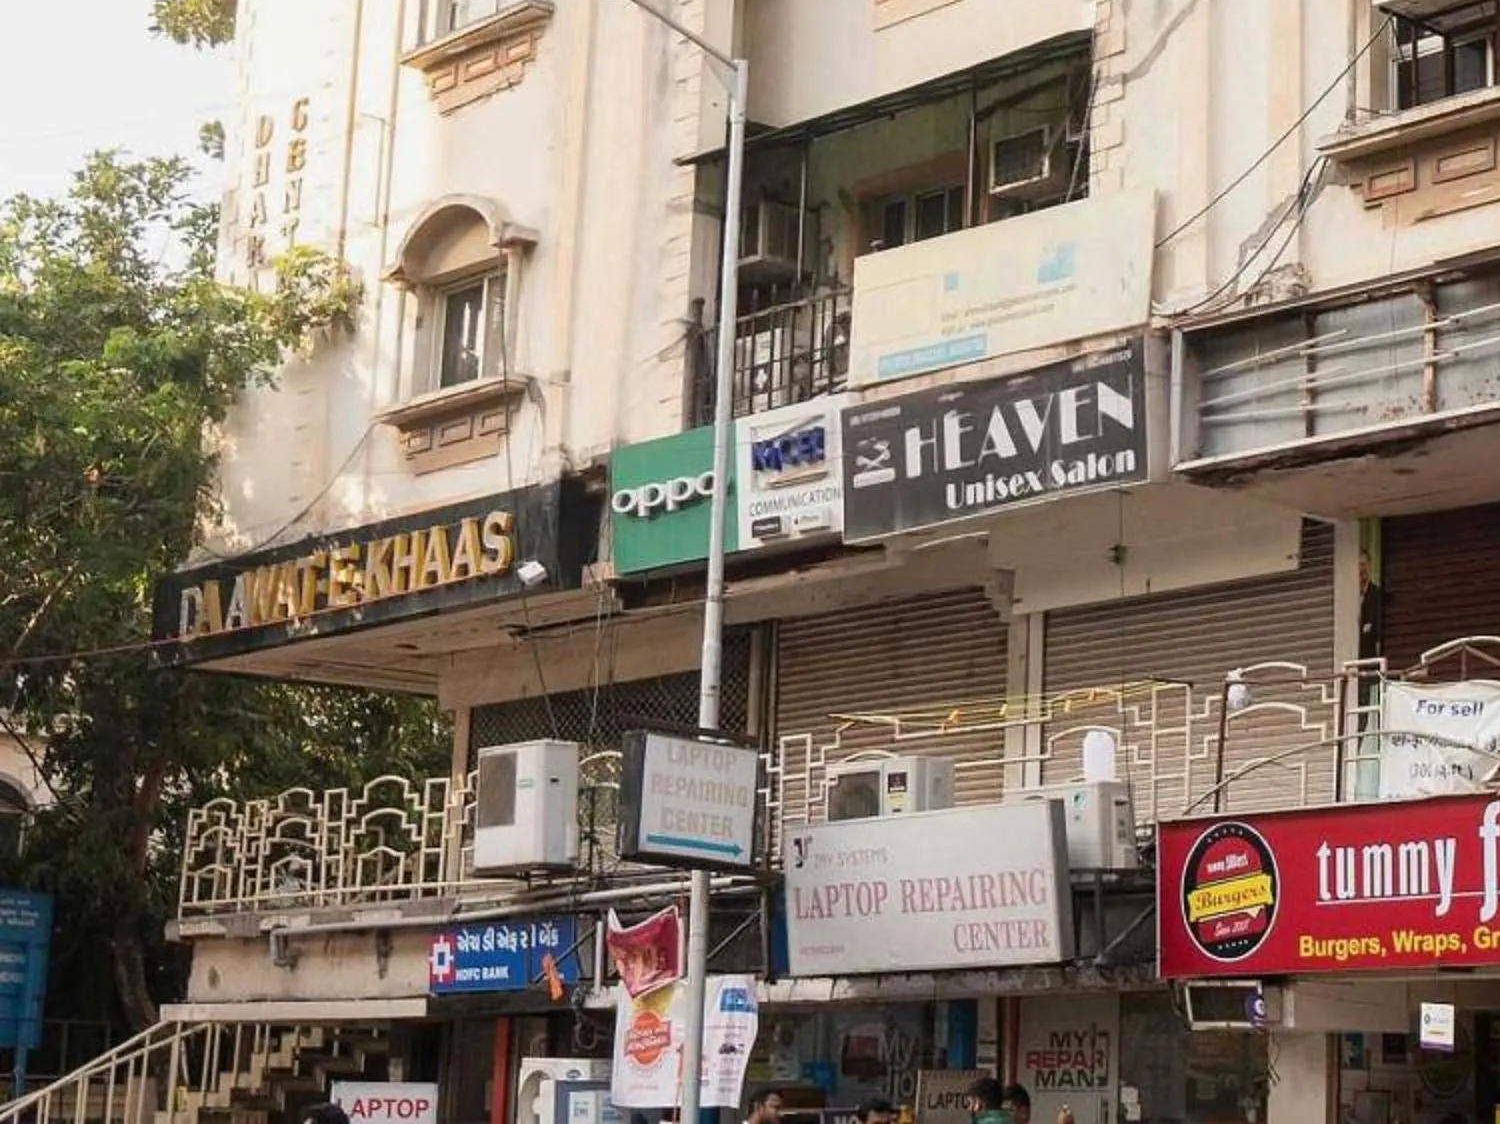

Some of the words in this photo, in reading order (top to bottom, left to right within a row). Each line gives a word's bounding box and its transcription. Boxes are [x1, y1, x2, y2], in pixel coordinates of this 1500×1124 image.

[904, 373, 1134, 479] HEAVEN
[611, 470, 716, 518] oppo
[945, 468, 1044, 509] Unisex
[1051, 448, 1137, 490] Salon
[1415, 699, 1446, 716] For
[1451, 700, 1484, 717] sell
[666, 739, 738, 773] LAPTOP
[661, 806, 734, 839] CENTER
[1315, 837, 1457, 917] tummy
[793, 879, 888, 921] LAPTOP
[899, 868, 1048, 914] REPAIRING
[1196, 883, 1267, 912] Burgers
[953, 918, 1050, 953] CENTER
[1299, 934, 1387, 961] Burgers,
[1392, 929, 1468, 957] Wraps,
[482, 965, 509, 980] BANK
[1049, 1029, 1089, 1048] MY
[1034, 1068, 1095, 1087] MAN
